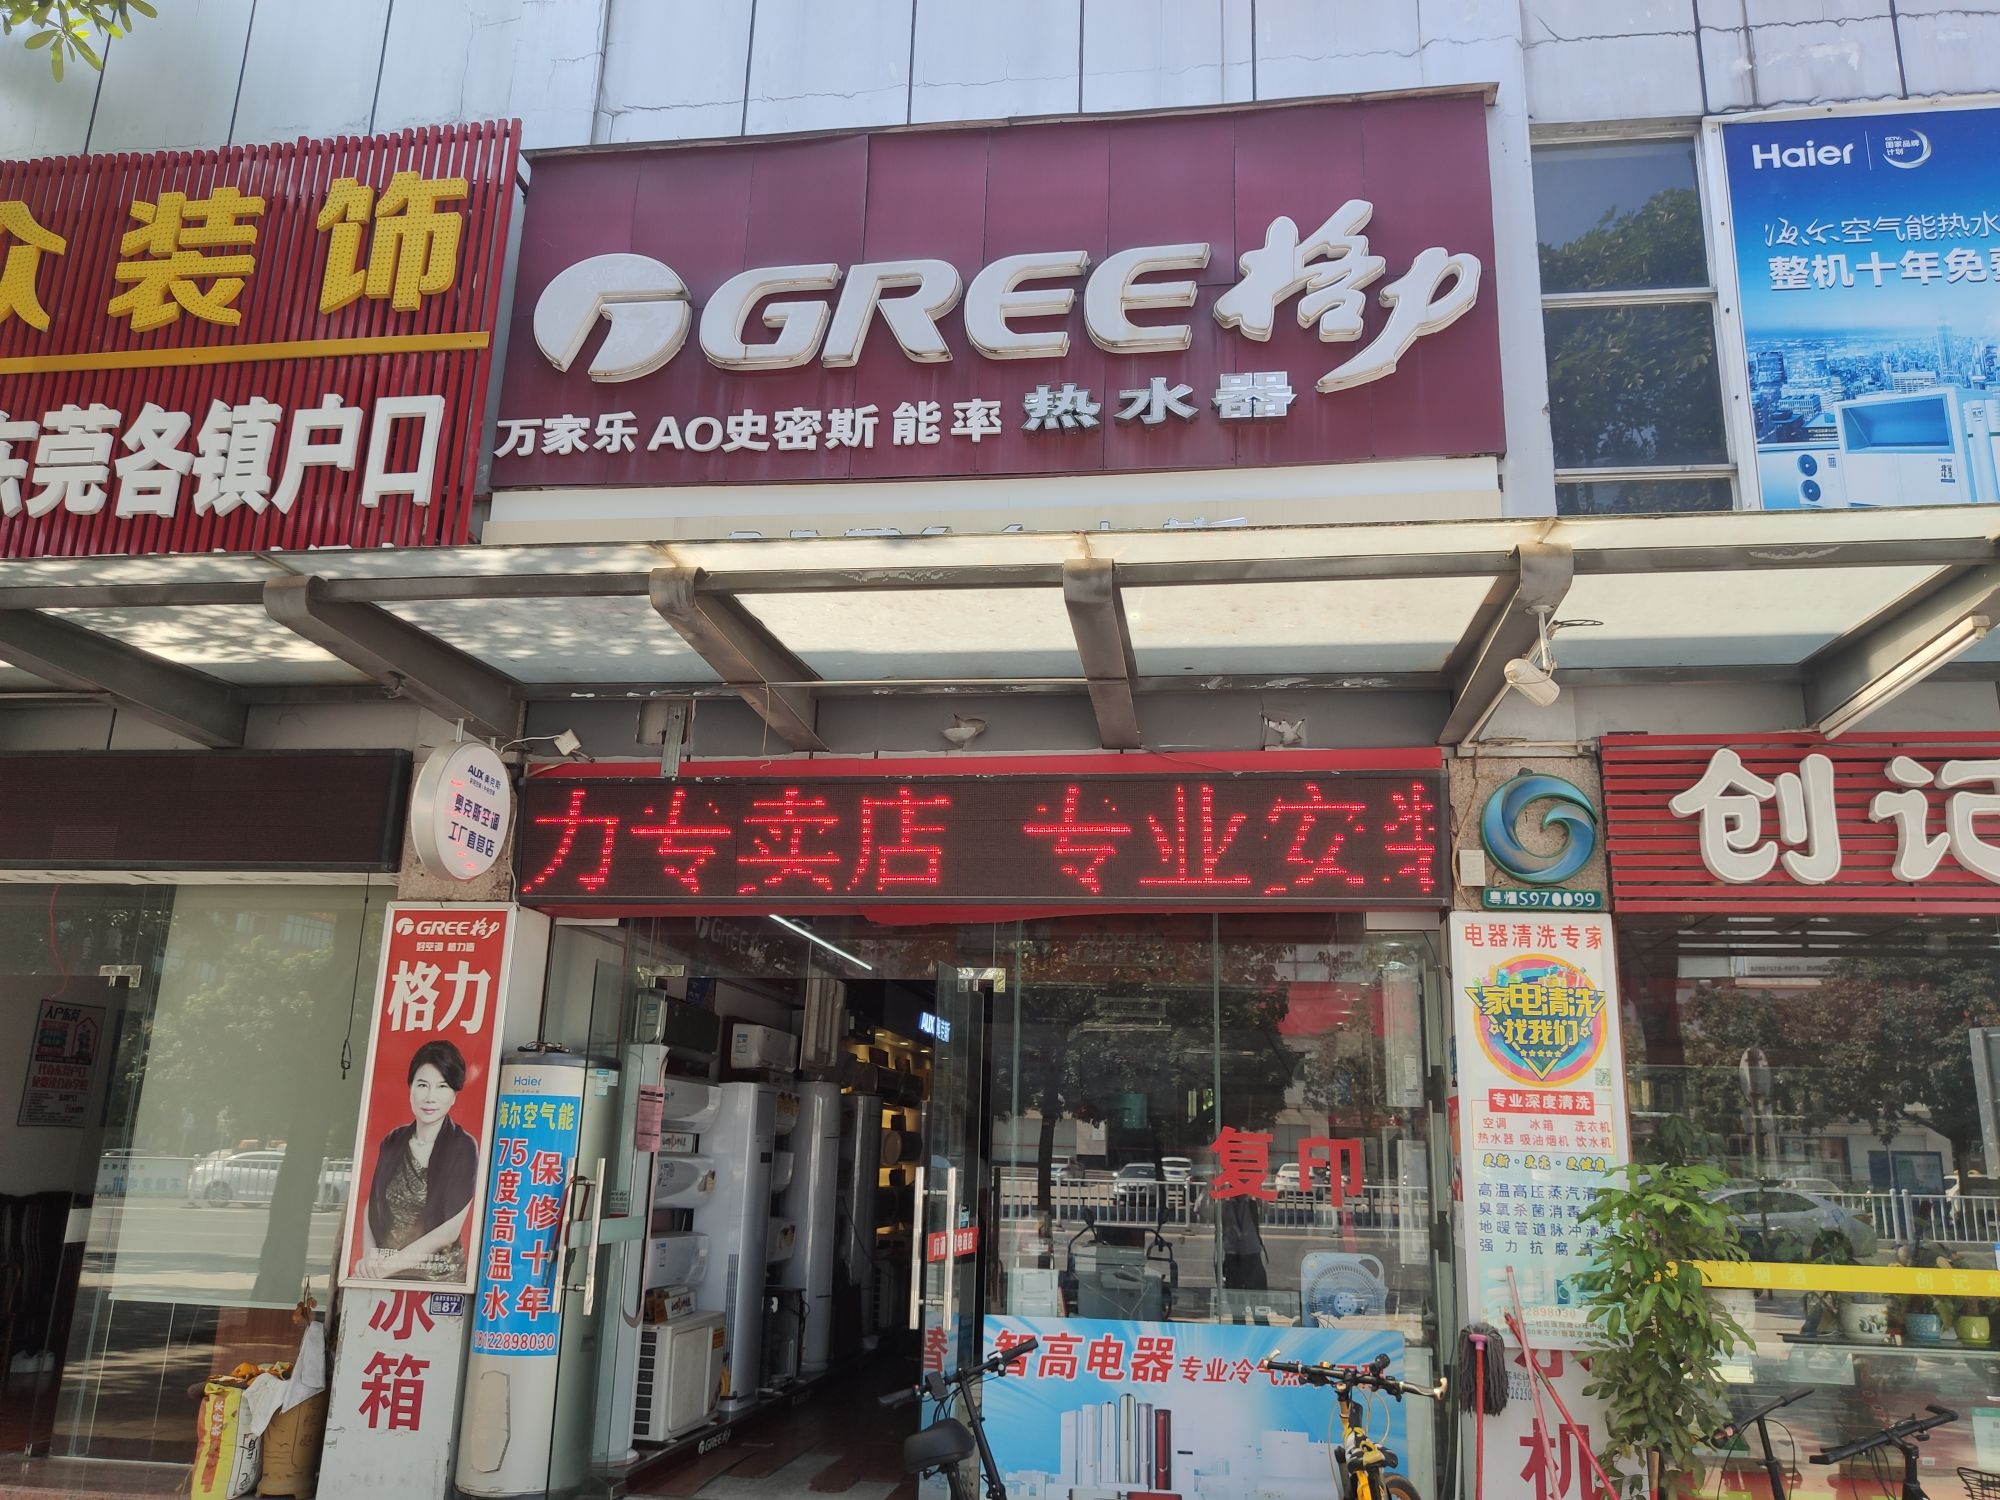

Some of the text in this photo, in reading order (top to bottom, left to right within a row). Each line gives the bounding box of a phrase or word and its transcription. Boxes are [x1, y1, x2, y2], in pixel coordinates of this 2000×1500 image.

[1752, 140, 1854, 170] Haier
[1885, 140, 1920, 149] 国家品牌
[1886, 148, 1904, 156] 计划
[1764, 210, 2000, 247] 海尔空气能热水
[700, 199, 1481, 393] GREE 格力
[494, 371, 1298, 457] 万家乐 AO史密斯 能率 热水器
[468, 765, 484, 780] AUX
[453, 793, 500, 831] 奥克斯空调
[1668, 748, 2000, 886] 创记
[448, 820, 495, 858] 工厂直营店
[521, 787, 951, 893] 力专卖店
[1488, 890, 1596, 908] 粤烟S970099
[416, 917, 500, 939] GREE 格力
[1464, 923, 1602, 950] 电器清洗专家
[387, 960, 492, 1035] 格力
[1481, 982, 1597, 1018] 家电清洗
[1502, 1018, 1581, 1046] 找我们
[513, 1075, 542, 1086] Haier
[1491, 1092, 1592, 1111] 专业深度清洗
[1482, 1118, 1611, 1133] 空调 冰箱 洗衣机
[1477, 1132, 1612, 1149] 热水器 吸油烟机 饮水机
[1209, 1126, 1363, 1208] 复印
[1478, 1182, 1598, 1201] 高温高压蒸汽清
[1479, 1202, 1618, 1220] 臭氧杀菌消毒
[514, 1149, 564, 1322] 保修十年
[1479, 1220, 1617, 1239] 地暖管道脉冲清洗
[1479, 1239, 1616, 1257] 强力抗腐清
[441, 1302, 458, 1313] 87
[358, 1290, 436, 1432] 冰箱
[994, 1329, 1177, 1385] 智高电器
